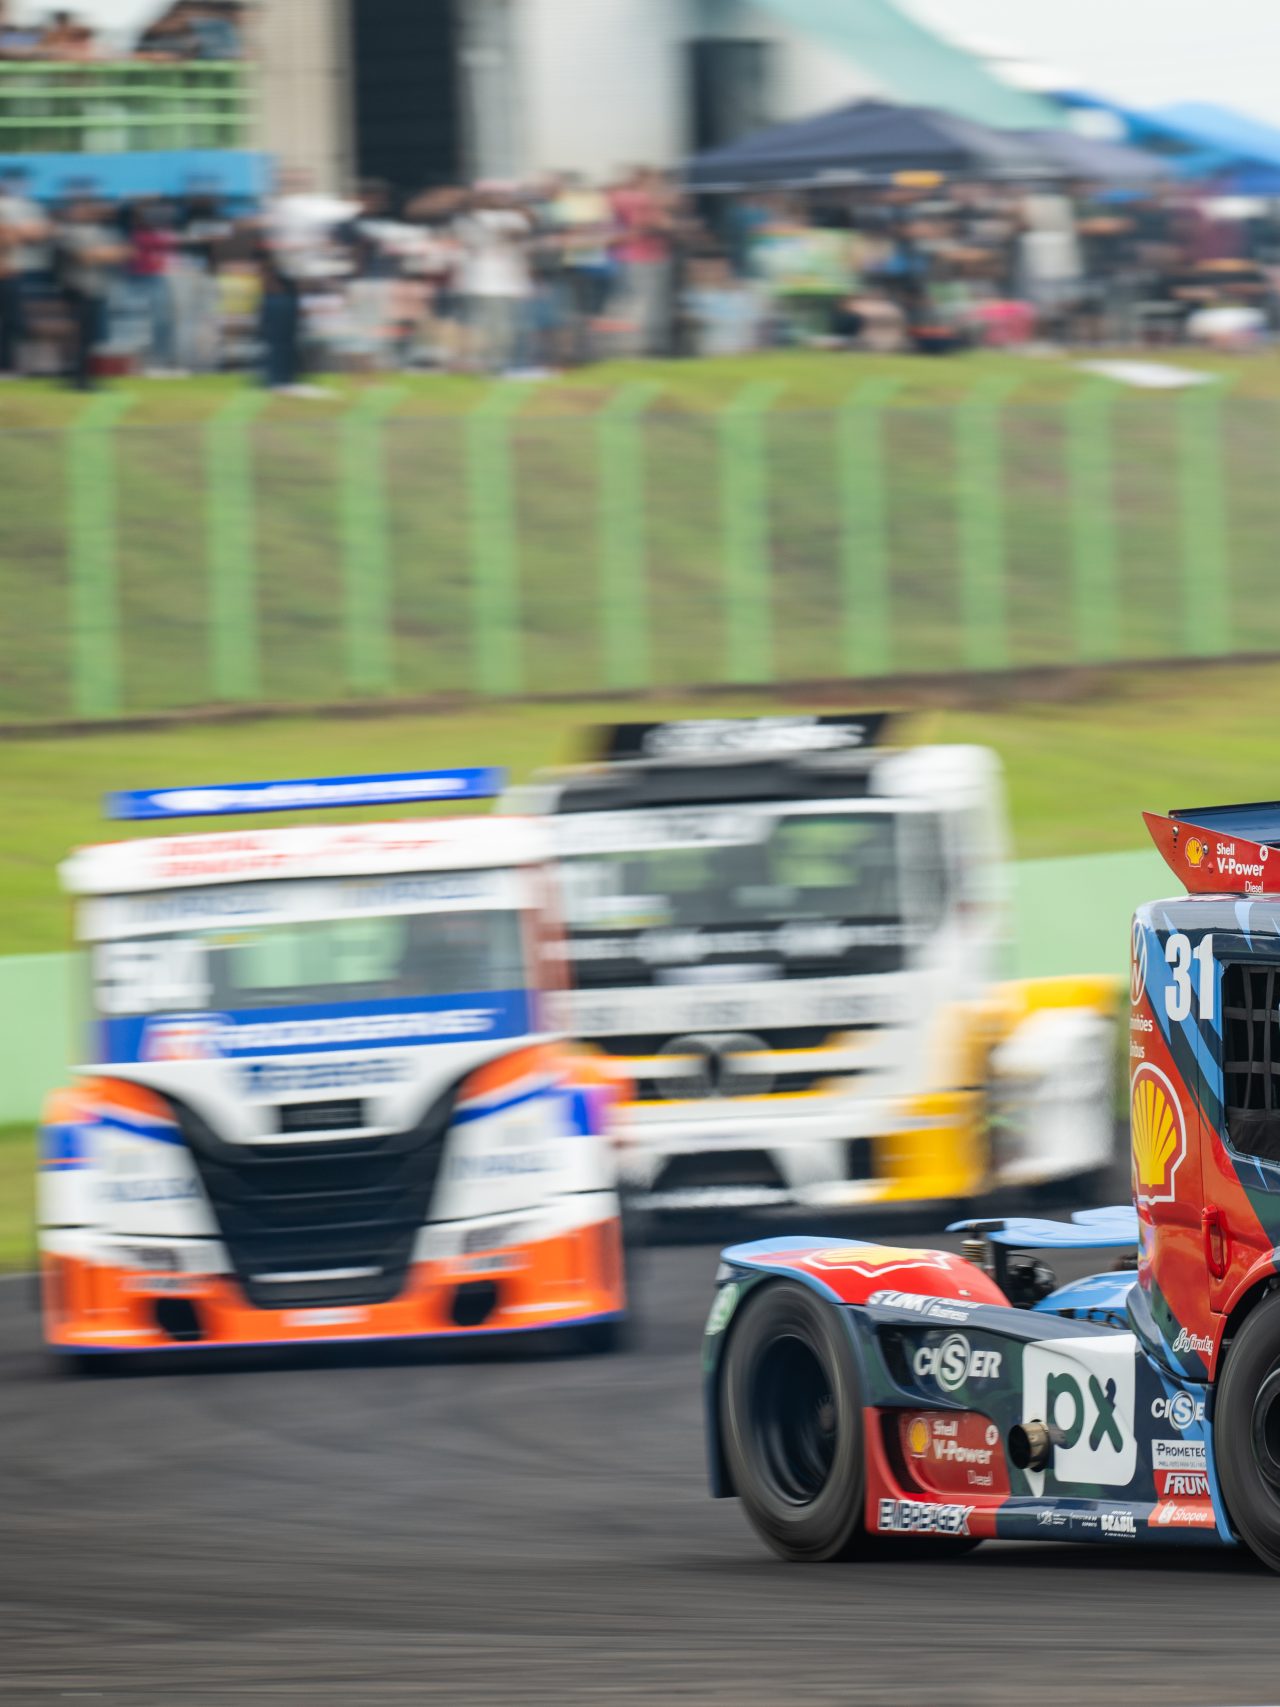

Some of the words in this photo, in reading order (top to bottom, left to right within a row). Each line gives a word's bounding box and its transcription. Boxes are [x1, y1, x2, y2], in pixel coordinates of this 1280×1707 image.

[1216, 843, 1235, 856] Shell
[1216, 857, 1265, 877] V-Power
[1244, 880, 1264, 894] Diesel
[1164, 933, 1214, 1022] 31
[913, 1338, 1002, 1388] CISER
[1151, 1394, 1205, 1428] CISE
[932, 1419, 959, 1437] Shell
[932, 1438, 993, 1465] V-Power
[1163, 1472, 1211, 1496] FRUM
[1173, 1507, 1208, 1526] Shopee
